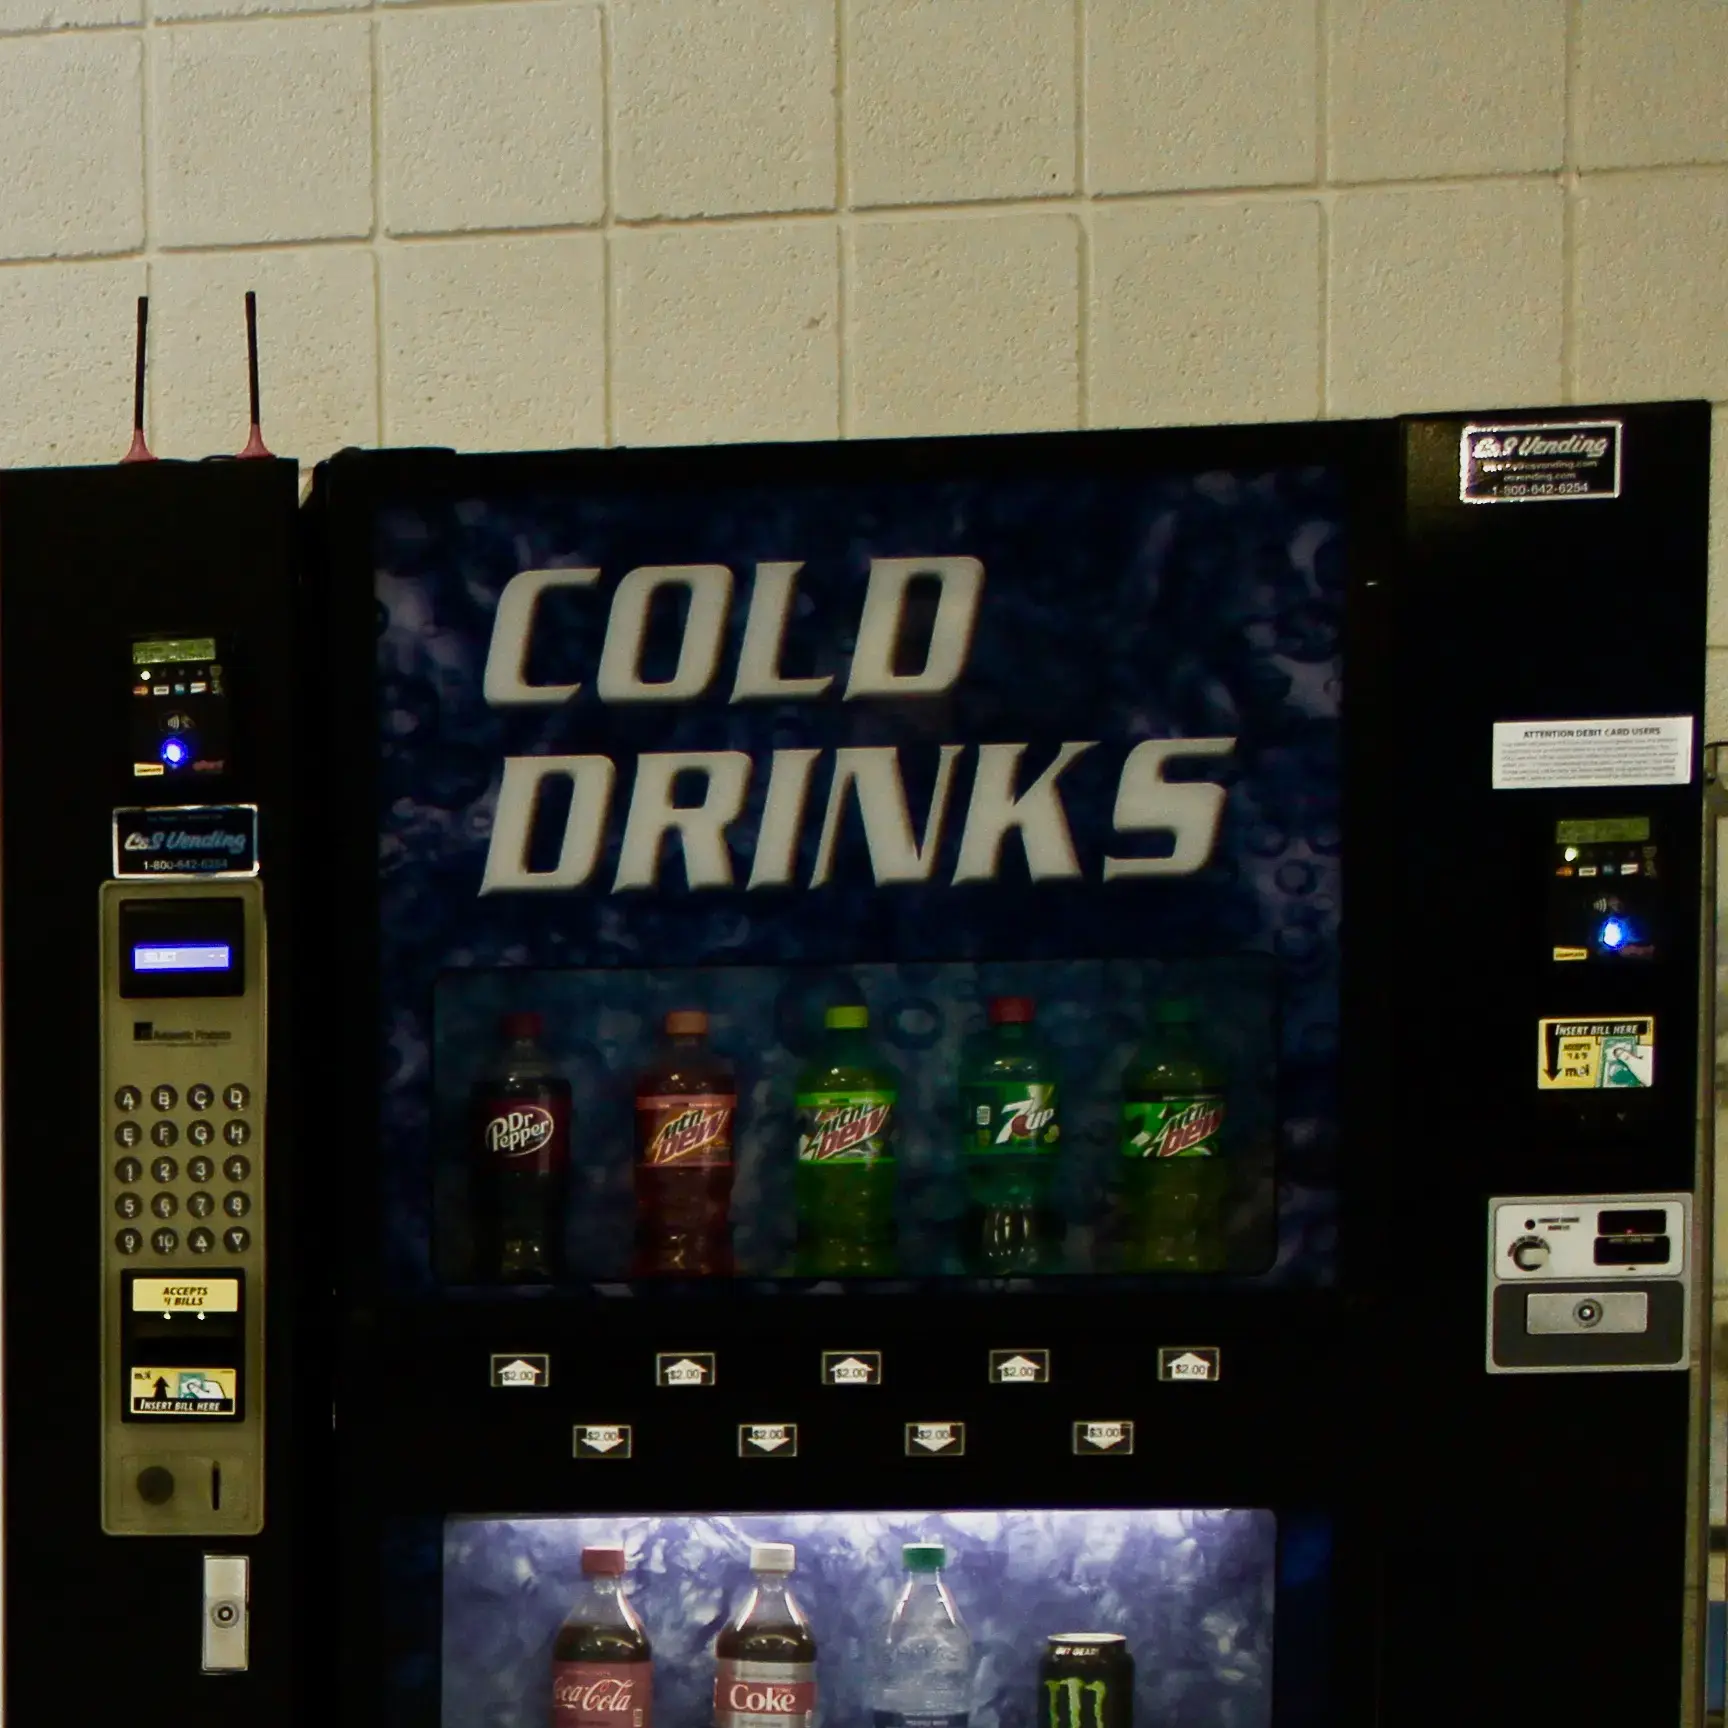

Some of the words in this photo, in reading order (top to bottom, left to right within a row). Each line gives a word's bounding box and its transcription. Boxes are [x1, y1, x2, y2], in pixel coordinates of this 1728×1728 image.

[1519, 435, 1608, 458] Vending
[484, 556, 986, 706] COLD
[1524, 730, 1574, 739] ATTENTION
[1576, 729, 1602, 737] DEBIT
[1605, 728, 1630, 736] CARD
[1632, 727, 1661, 736] USERS
[479, 737, 1237, 898] DRINKS
[166, 830, 246, 855] Vending
[1555, 1025, 1589, 1036] INSERT
[1590, 1025, 1610, 1035] BILL
[1613, 1024, 1638, 1034] HERE
[124, 1093, 134, 1105] A
[159, 1092, 169, 1105] B
[194, 1091, 206, 1104] C
[230, 1090, 242, 1103] D
[508, 1112, 534, 1134] Dr
[124, 1128, 133, 1141] E
[160, 1127, 169, 1140] F
[195, 1126, 206, 1140] G
[231, 1126, 242, 1139] H
[491, 1117, 549, 1152] Pepper
[126, 1164, 132, 1177] 1
[160, 1164, 169, 1177] 2
[196, 1163, 206, 1176] 3
[232, 1162, 241, 1174] 4
[124, 1200, 134, 1212] 5
[160, 1199, 169, 1212] 6
[197, 1199, 205, 1210] 7
[232, 1197, 242, 1210] 8
[125, 1235, 134, 1248] 9
[158, 1235, 173, 1247] 10
[162, 1287, 208, 1296] ACCEPTS
[174, 1297, 203, 1306] BILLS
[504, 1370, 534, 1382] $2.00
[669, 1369, 700, 1381] $2.00
[836, 1368, 867, 1379] $2.00
[1003, 1366, 1034, 1378] $2.00
[1175, 1365, 1206, 1376] $2.00
[140, 1398, 172, 1410] INSERT
[175, 1401, 193, 1410] BILL
[196, 1401, 221, 1411] HERE
[587, 1430, 617, 1441] $2.00
[753, 1429, 784, 1440] $2.00
[919, 1429, 949, 1440] $2.00
[1088, 1427, 1119, 1438] $3.00
[730, 1684, 797, 1713] Coke
